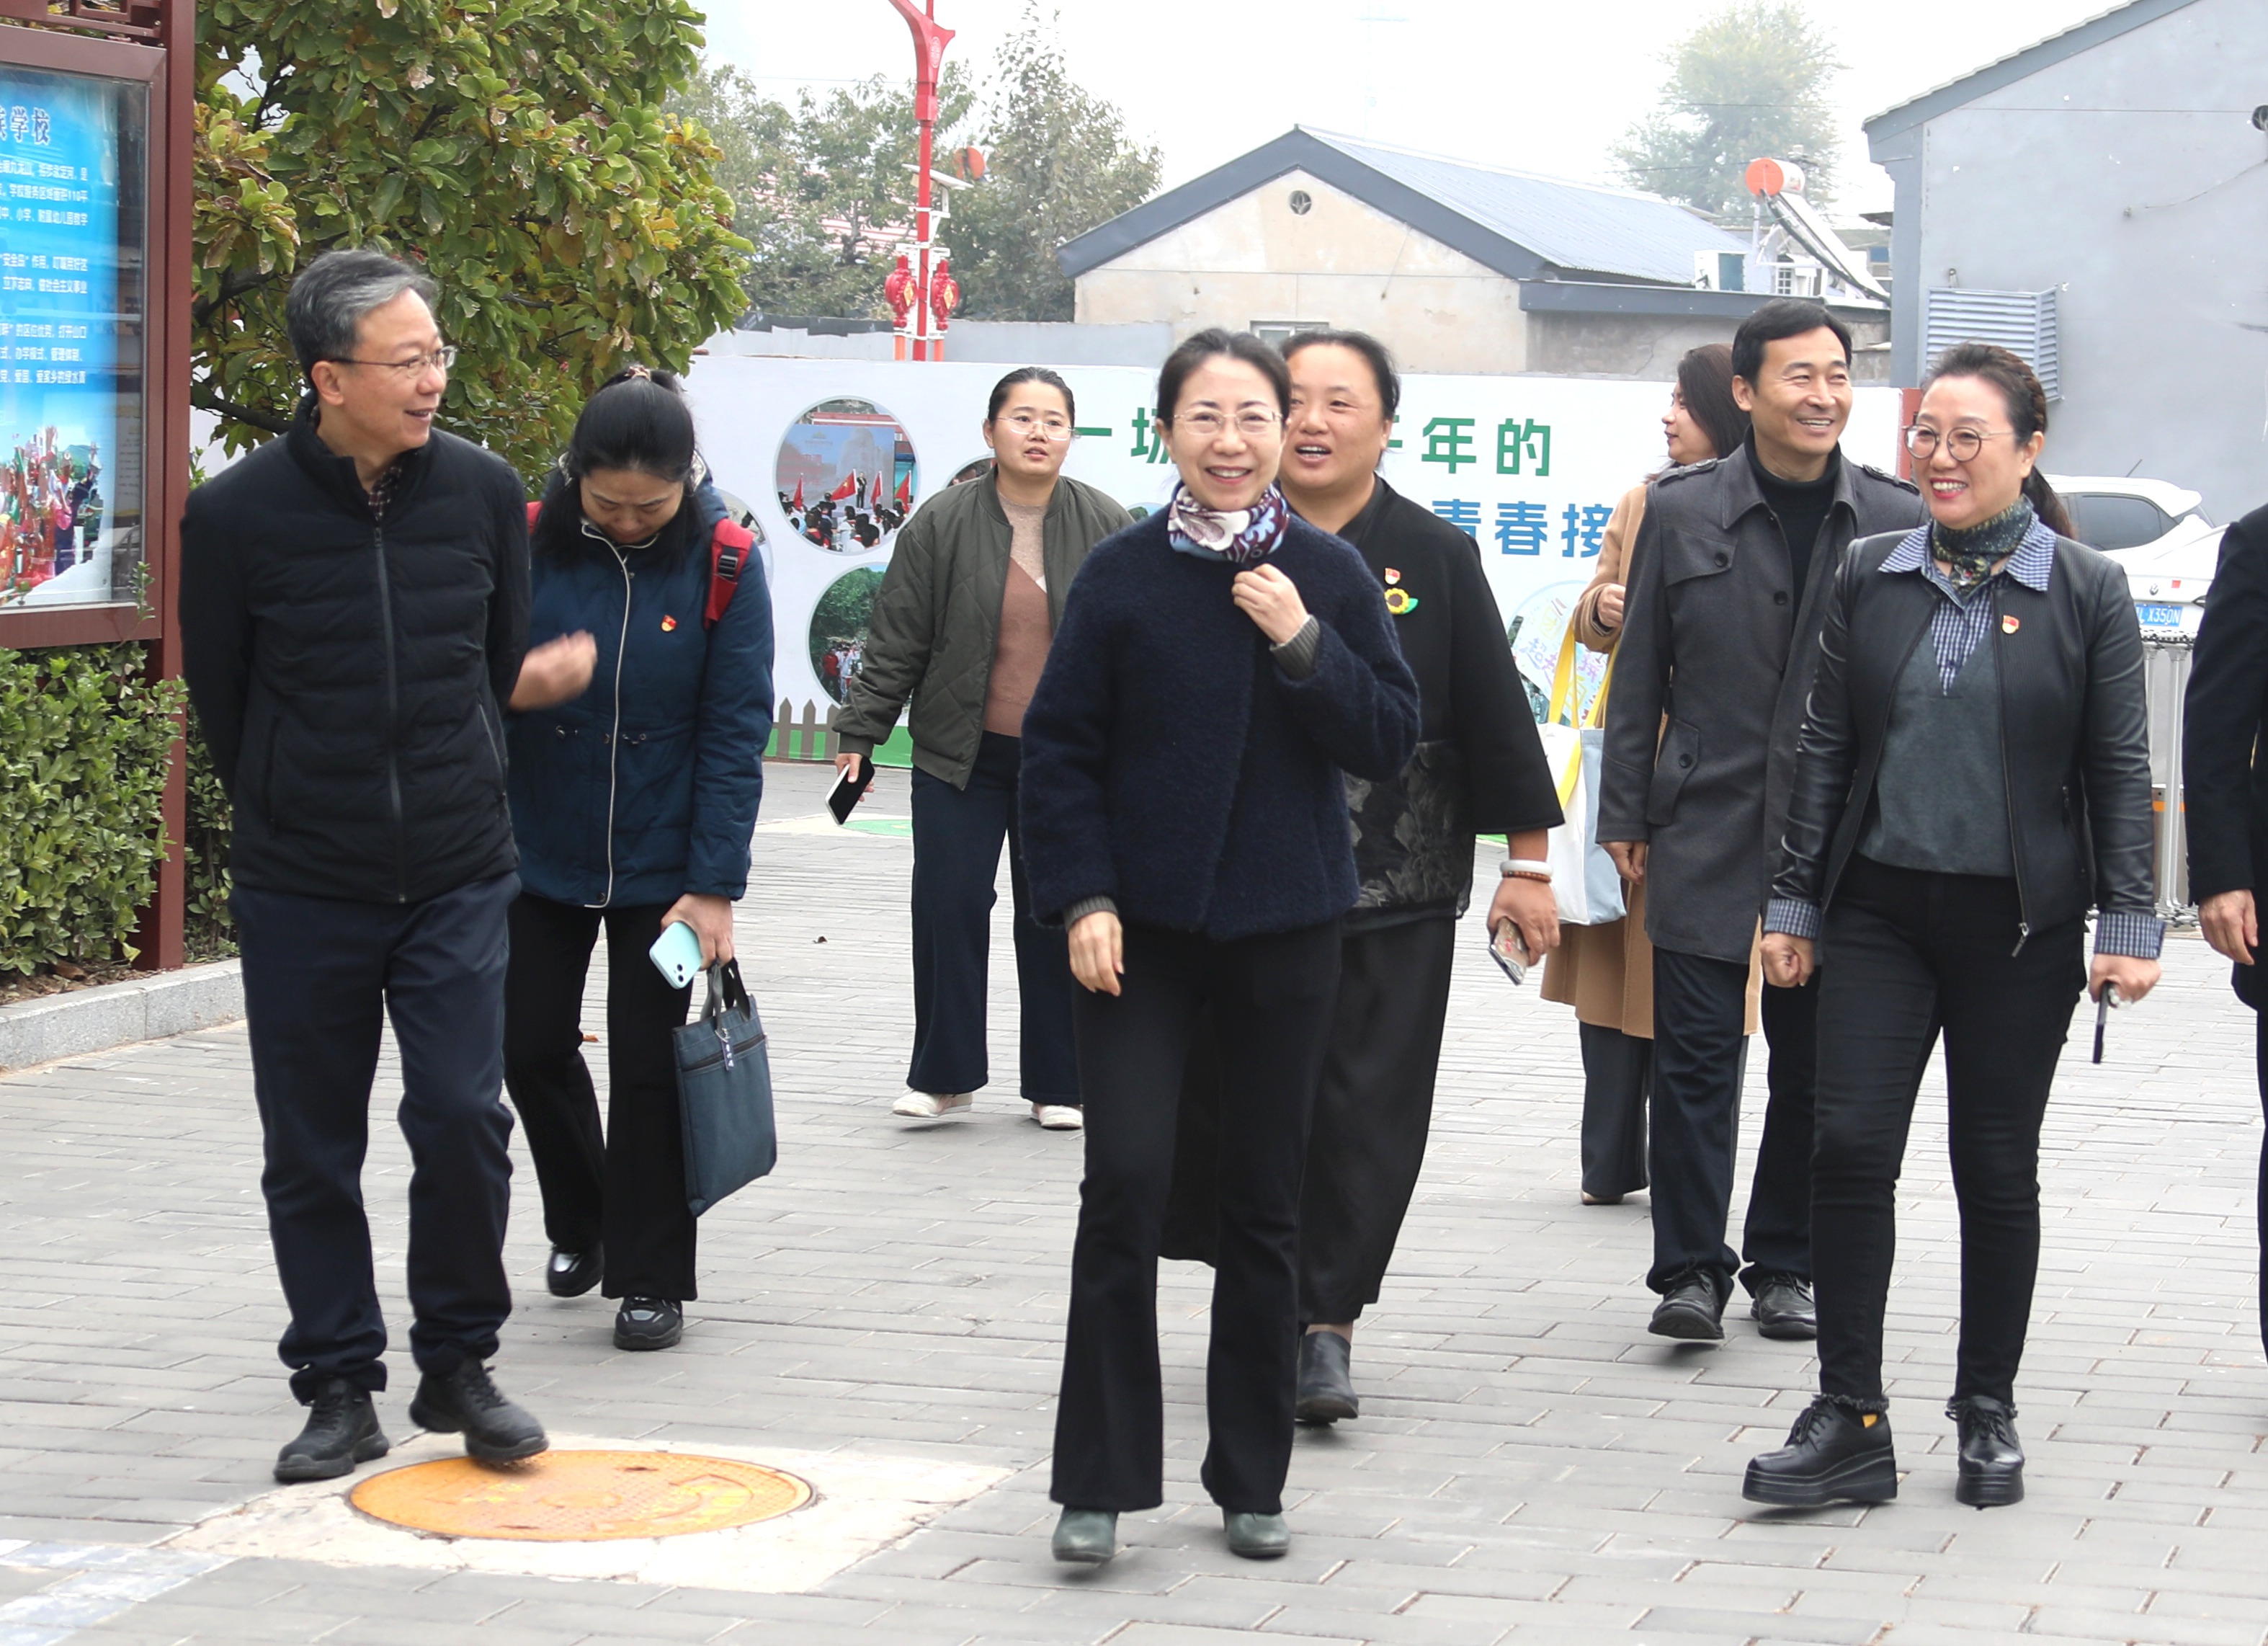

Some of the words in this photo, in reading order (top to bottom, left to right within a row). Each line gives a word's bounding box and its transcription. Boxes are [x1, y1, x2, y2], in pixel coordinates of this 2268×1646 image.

[1388, 415, 1550, 476] 年的
[1432, 499, 1613, 558] 青春接
